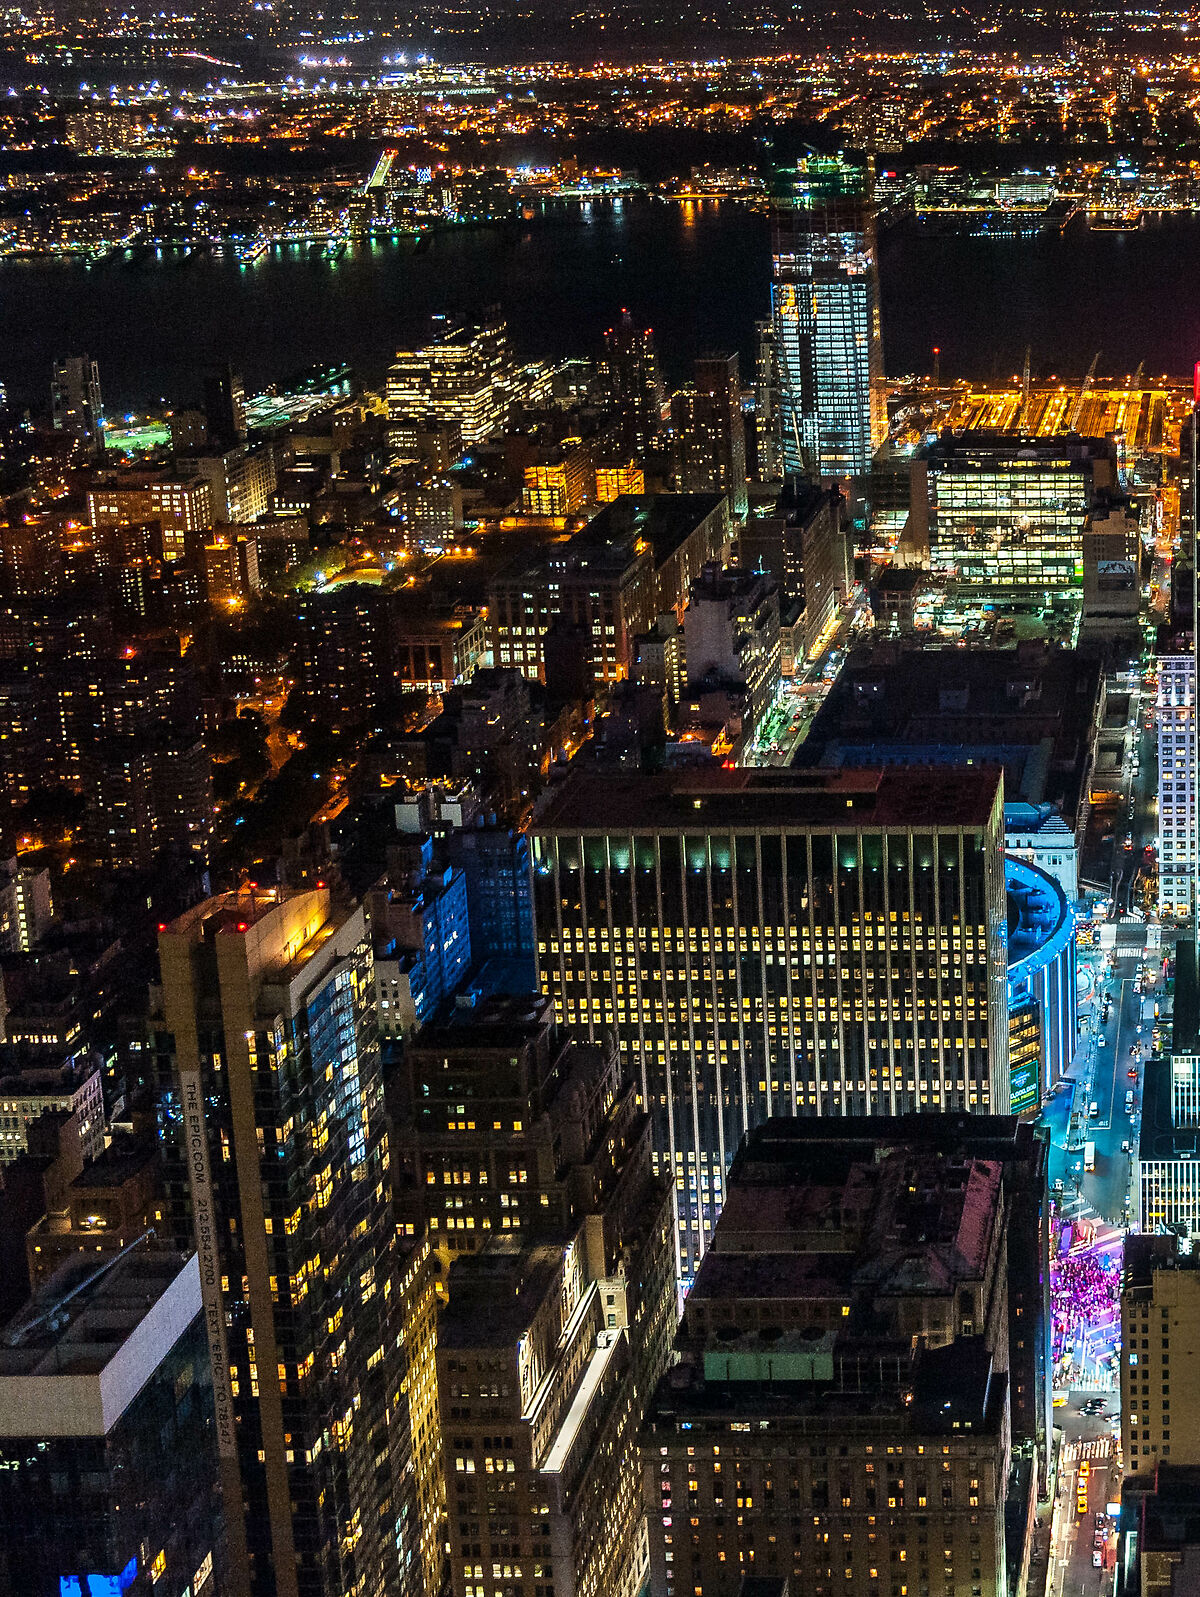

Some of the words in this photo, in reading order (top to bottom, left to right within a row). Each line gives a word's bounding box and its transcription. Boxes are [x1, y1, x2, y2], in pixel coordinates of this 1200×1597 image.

[186, 1082, 197, 1110] THE
[189, 1115, 206, 1183] EPIC.COM
[208, 1302, 220, 1335] TEXT
[217, 1386, 226, 1402] TO
